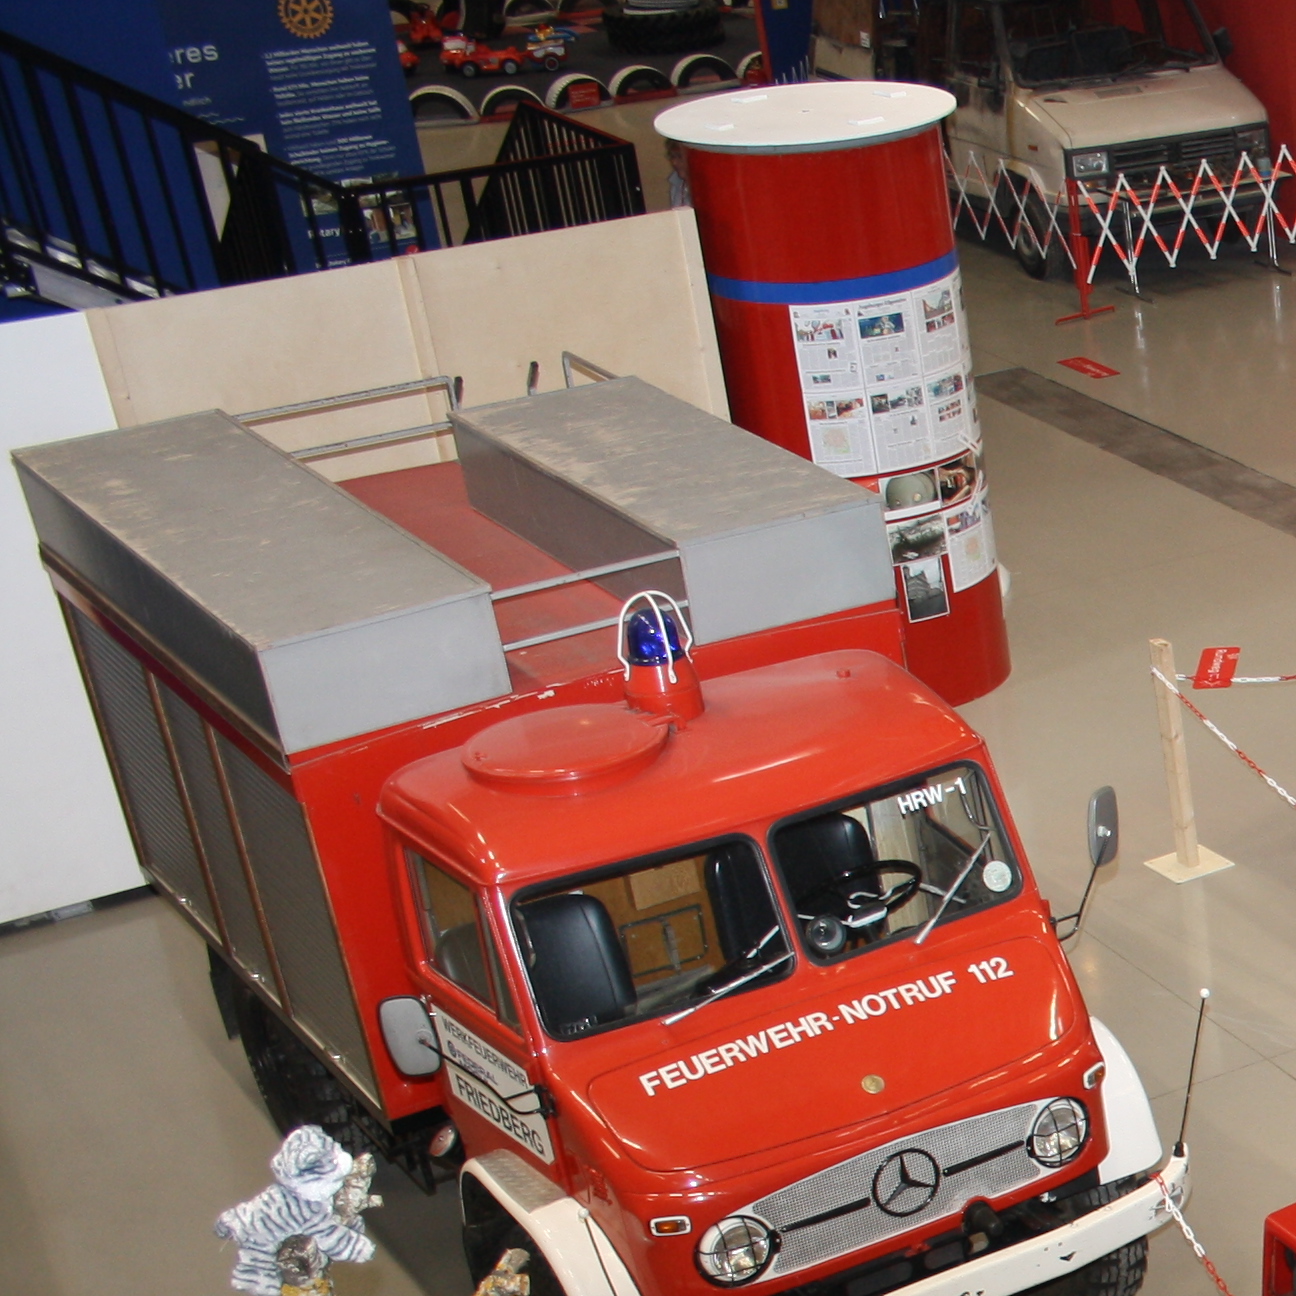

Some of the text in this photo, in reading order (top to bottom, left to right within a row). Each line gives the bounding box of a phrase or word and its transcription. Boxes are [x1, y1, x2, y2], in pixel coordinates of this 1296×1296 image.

[169, 44, 219, 65] res
[308, 227, 340, 239] Rtary
[897, 777, 966, 815] HRW-1
[638, 956, 1014, 1097] FEUERWEHR-NOTRUF 112
[456, 1073, 546, 1157] FRIEDBERG
